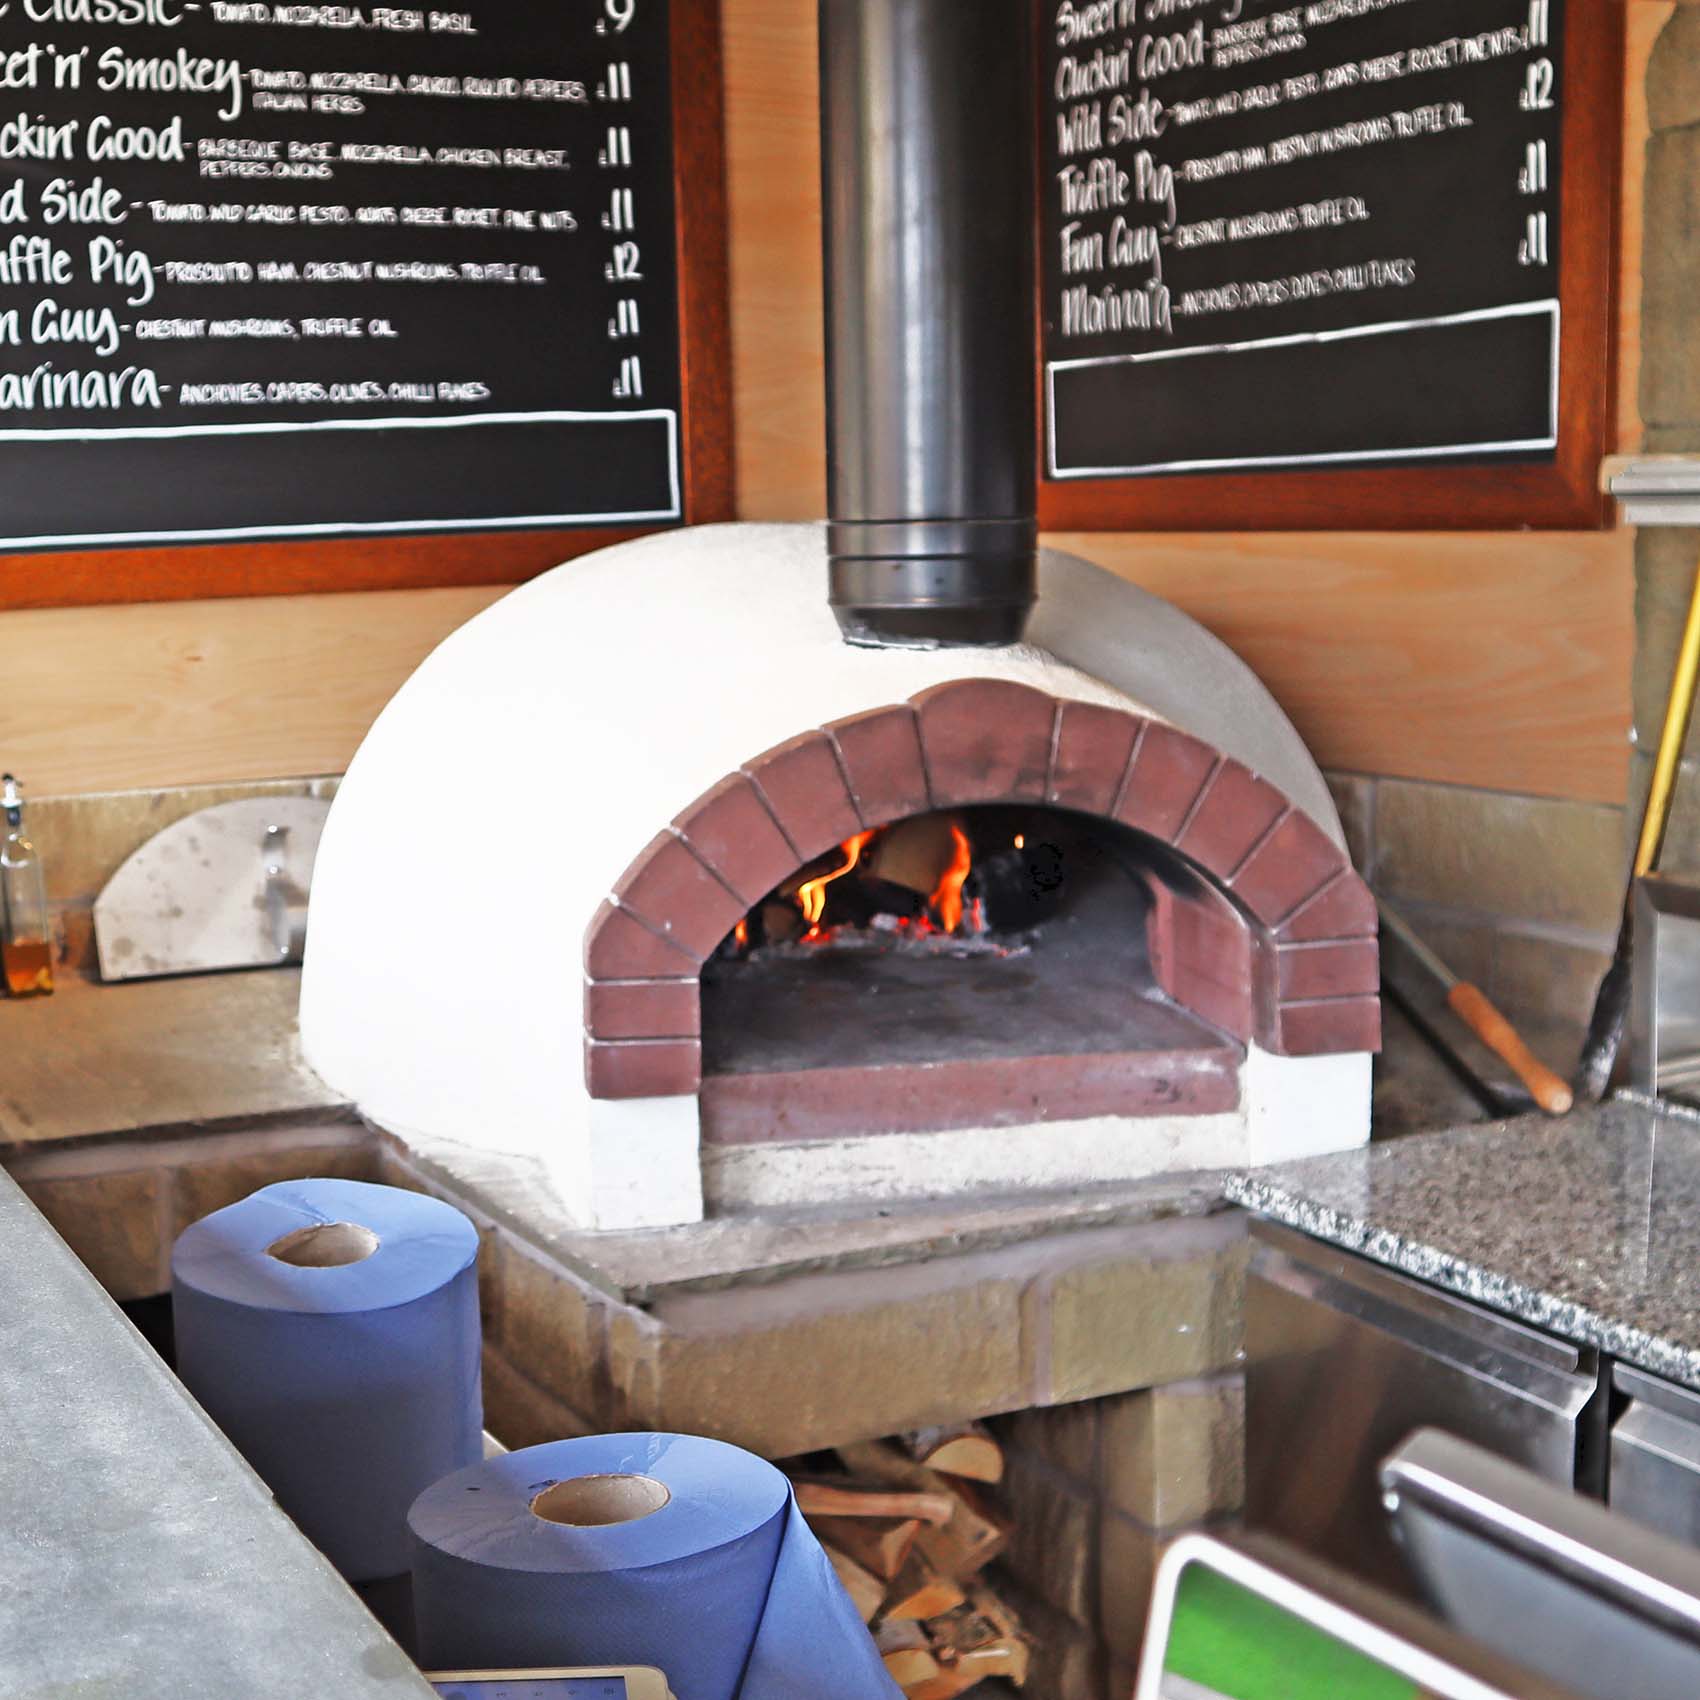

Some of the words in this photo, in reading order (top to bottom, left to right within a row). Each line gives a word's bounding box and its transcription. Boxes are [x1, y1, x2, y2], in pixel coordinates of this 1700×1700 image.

[371, 8, 425, 31] FRESH
[429, 11, 479, 34] BASIL
[368, 319, 399, 338] OIL
